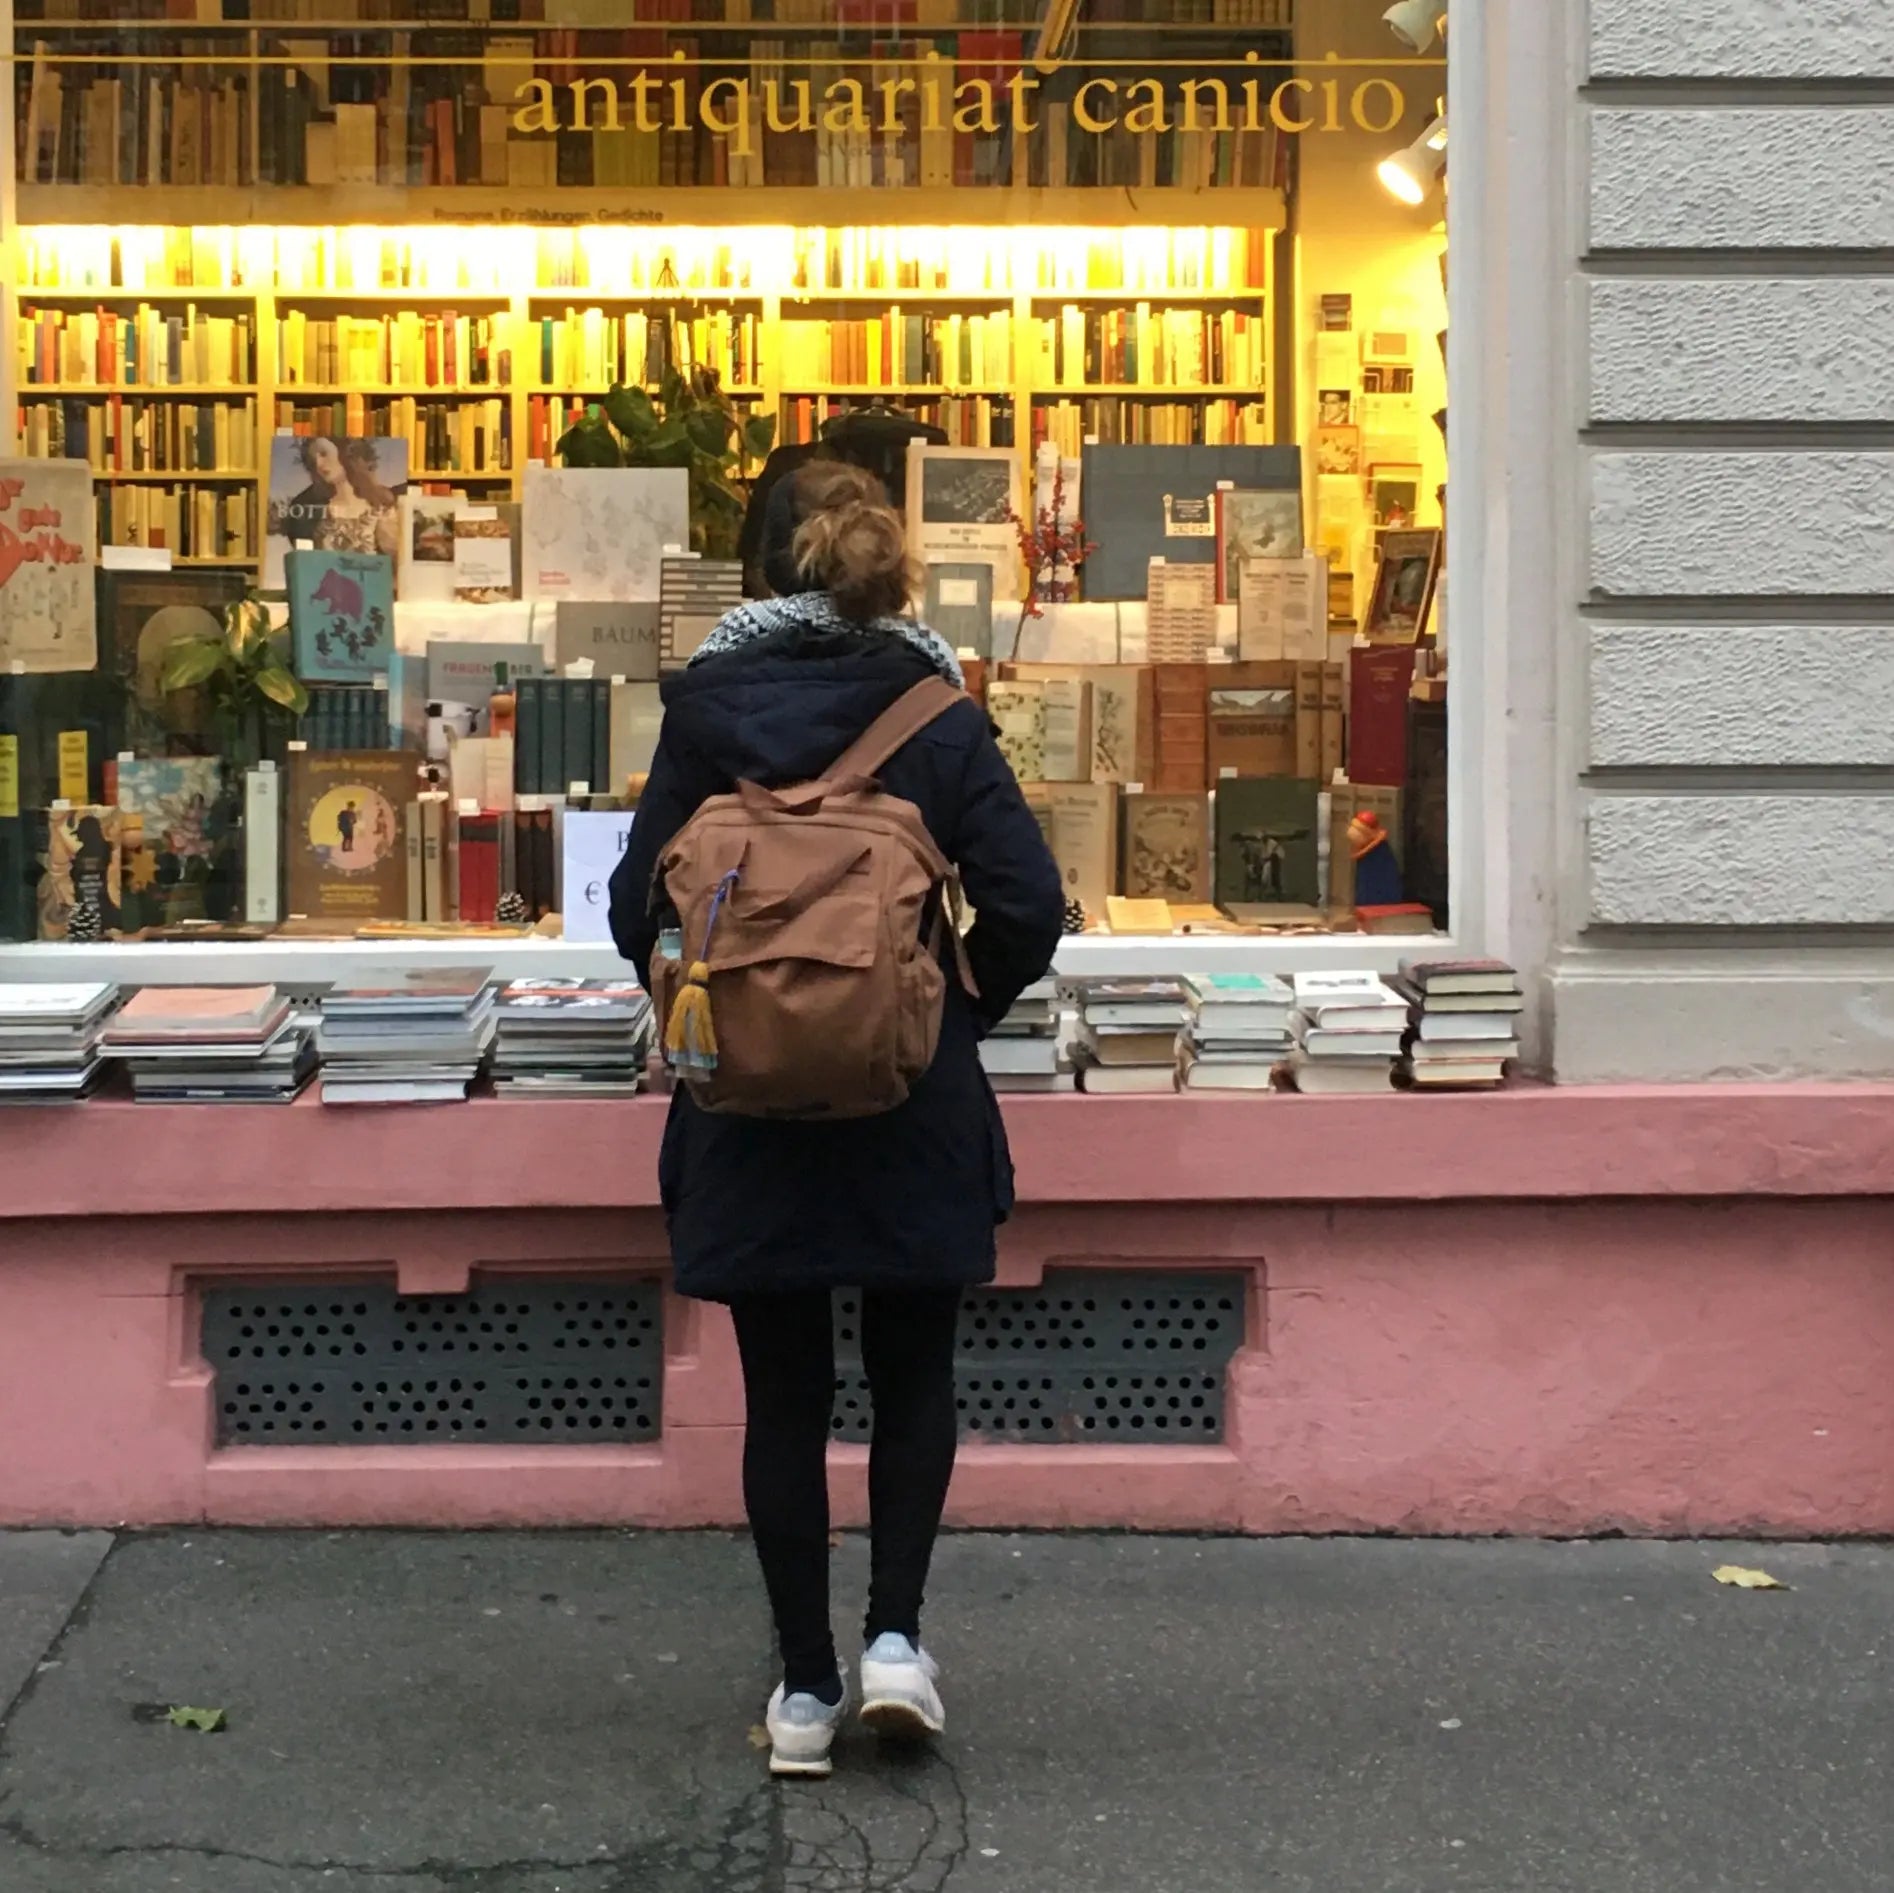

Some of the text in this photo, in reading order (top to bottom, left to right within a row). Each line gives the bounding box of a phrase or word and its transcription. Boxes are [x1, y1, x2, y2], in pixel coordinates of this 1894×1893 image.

[513, 50, 1404, 156] antiquariat canicio
[592, 625, 656, 644] BAUM
